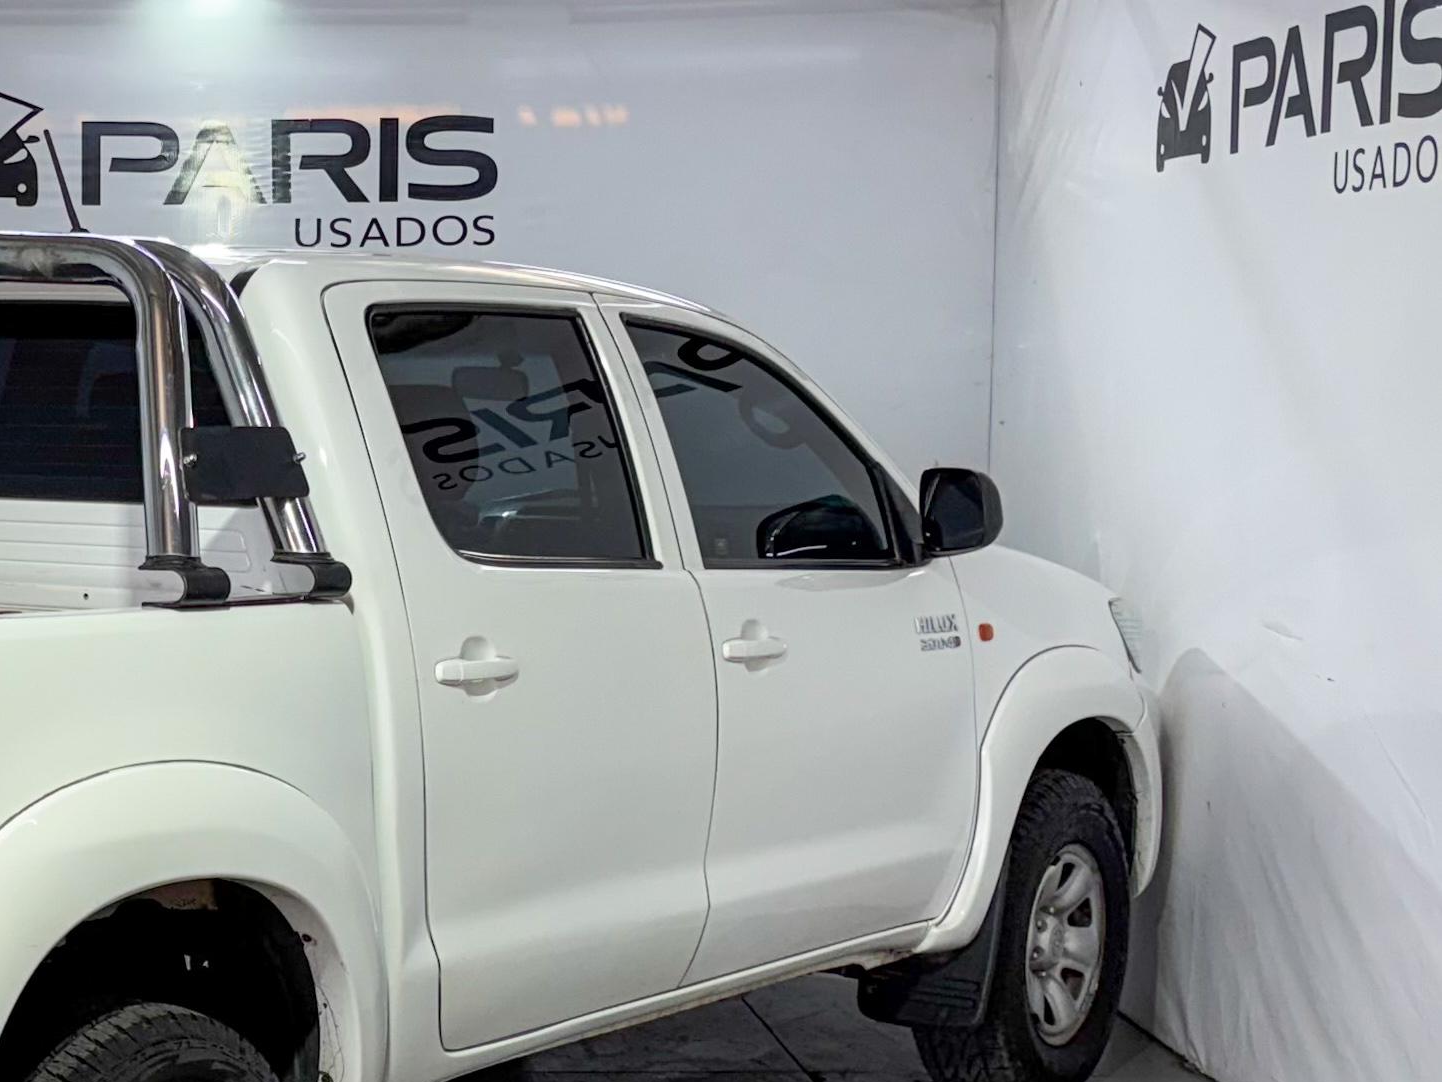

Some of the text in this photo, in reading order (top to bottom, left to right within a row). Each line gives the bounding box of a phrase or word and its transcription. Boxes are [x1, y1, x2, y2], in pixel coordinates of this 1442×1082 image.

[1229, 0, 1442, 155] PARIS
[81, 114, 499, 206] PARIS
[295, 215, 496, 249] USADOS
[913, 613, 958, 634] HILUX
